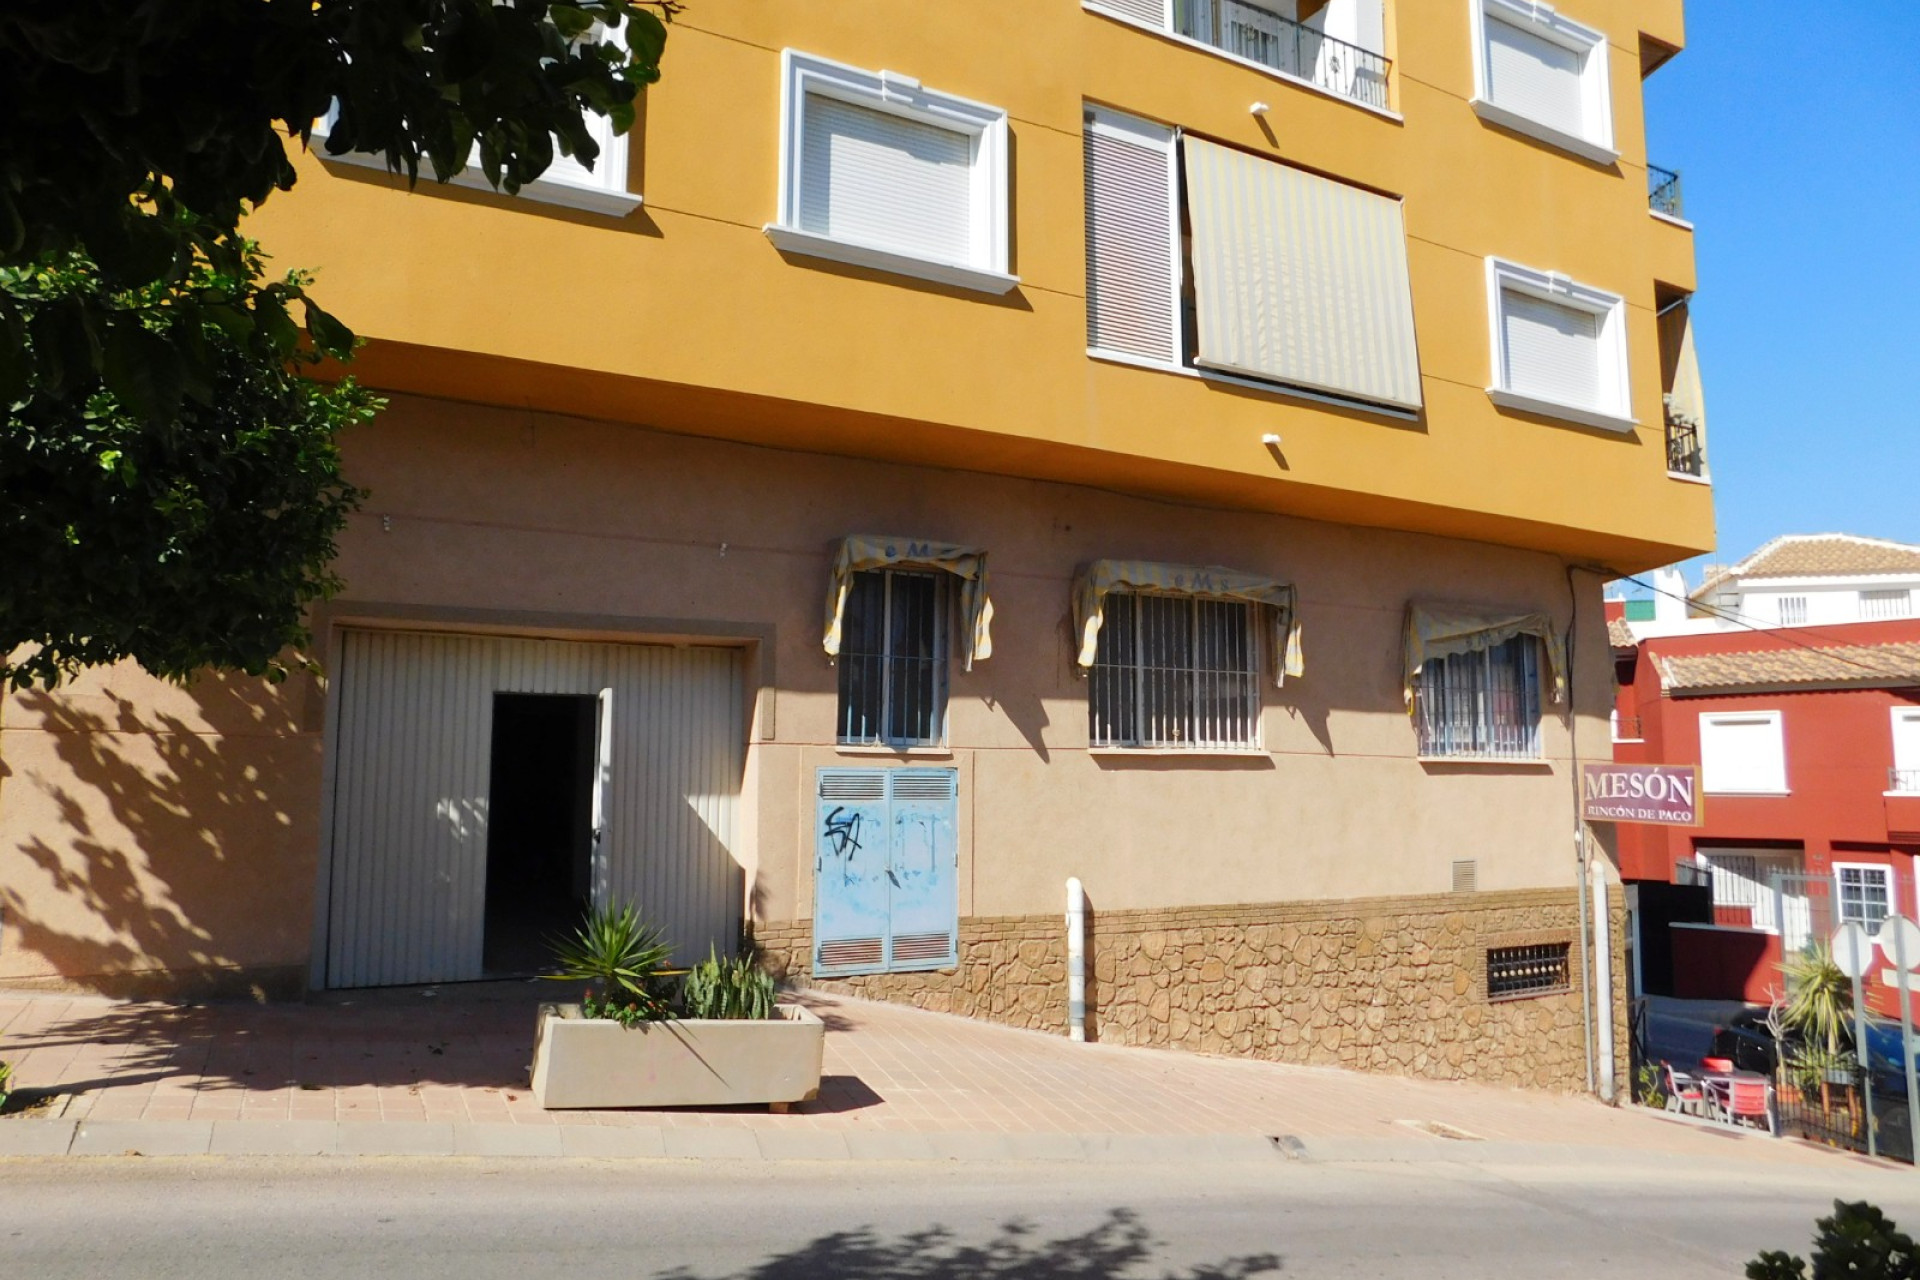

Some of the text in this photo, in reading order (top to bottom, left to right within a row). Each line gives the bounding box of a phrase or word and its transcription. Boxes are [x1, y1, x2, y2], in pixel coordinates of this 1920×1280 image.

[1584, 767, 1693, 806] MESÓN
[1588, 805, 1692, 821] RINCÓN DE PACO
